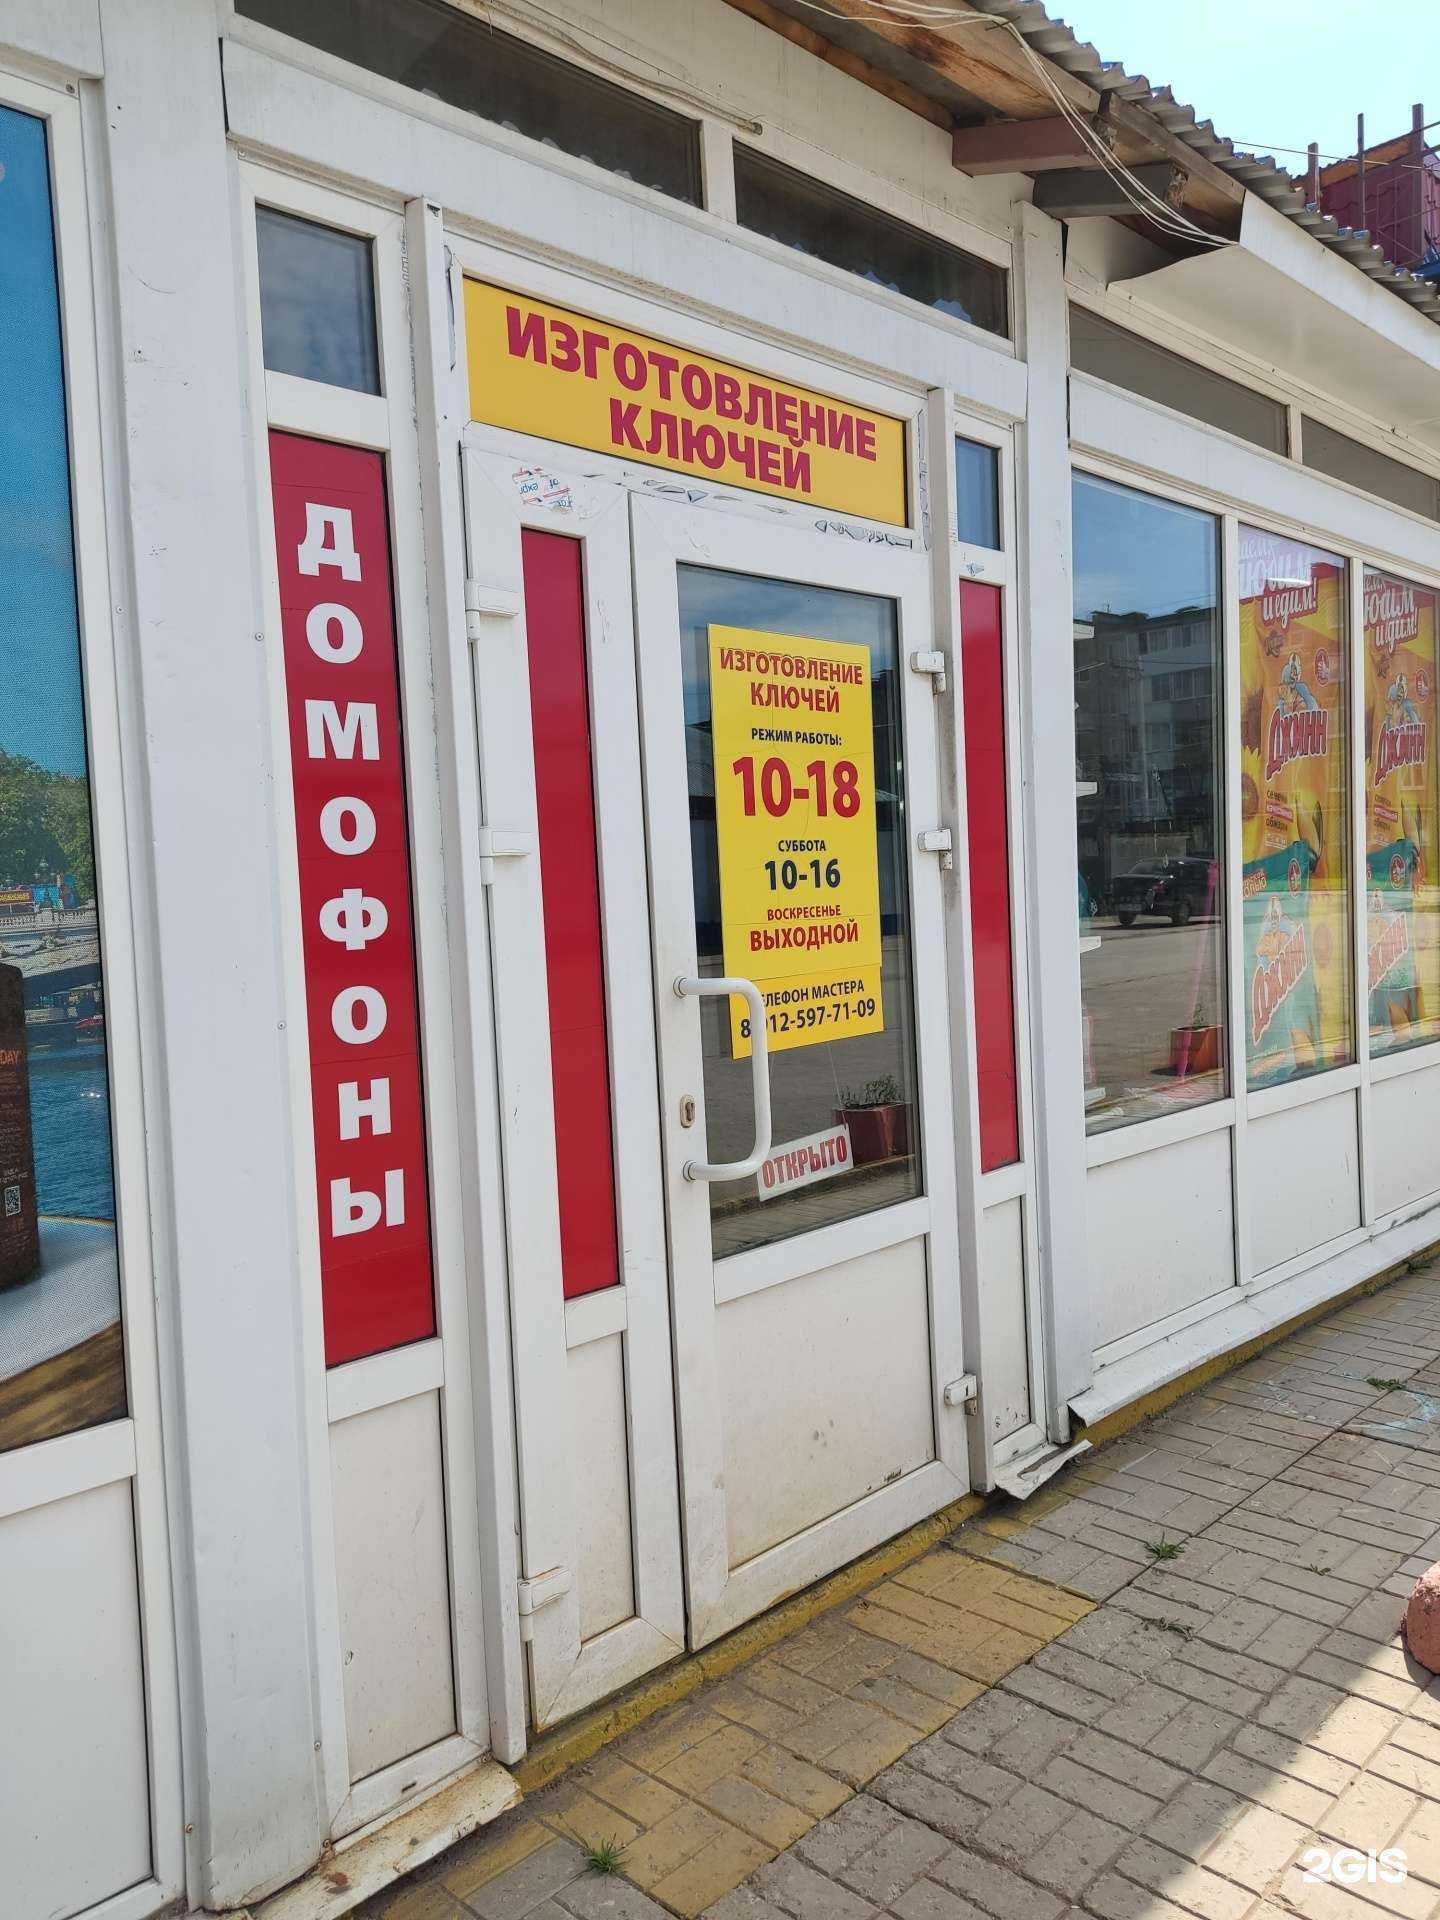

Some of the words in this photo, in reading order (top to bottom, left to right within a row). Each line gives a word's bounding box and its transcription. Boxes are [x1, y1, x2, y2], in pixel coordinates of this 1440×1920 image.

[505, 305, 877, 462] ИЗГОТОВЛЕНИЕ
[609, 397, 812, 494] КЛЮЧЕЙ
[719, 647, 863, 685] ИЗГОТОВЛЕНИЕ
[750, 682, 840, 713] КЛЮЧЕЙ
[751, 727, 793, 743] РЕЖИМ
[795, 731, 843, 746] РАБОТЫ:
[732, 756, 861, 818] 10-18
[778, 839, 826, 852] СУББОТА
[297, 502, 406, 1238] ДОМОФОНЫ
[764, 858, 841, 890] 10-16
[767, 904, 841, 921] ВОСКРЕСЕНЬЕ
[749, 918, 859, 952] ВЫХОДНОЙ
[762, 988, 808, 1008] ЛЕФОН
[811, 979, 865, 999] МАСТЕРА
[740, 998, 876, 1038] 812-597-71-09
[762, 1135, 848, 1189] ОТКРЫТО
